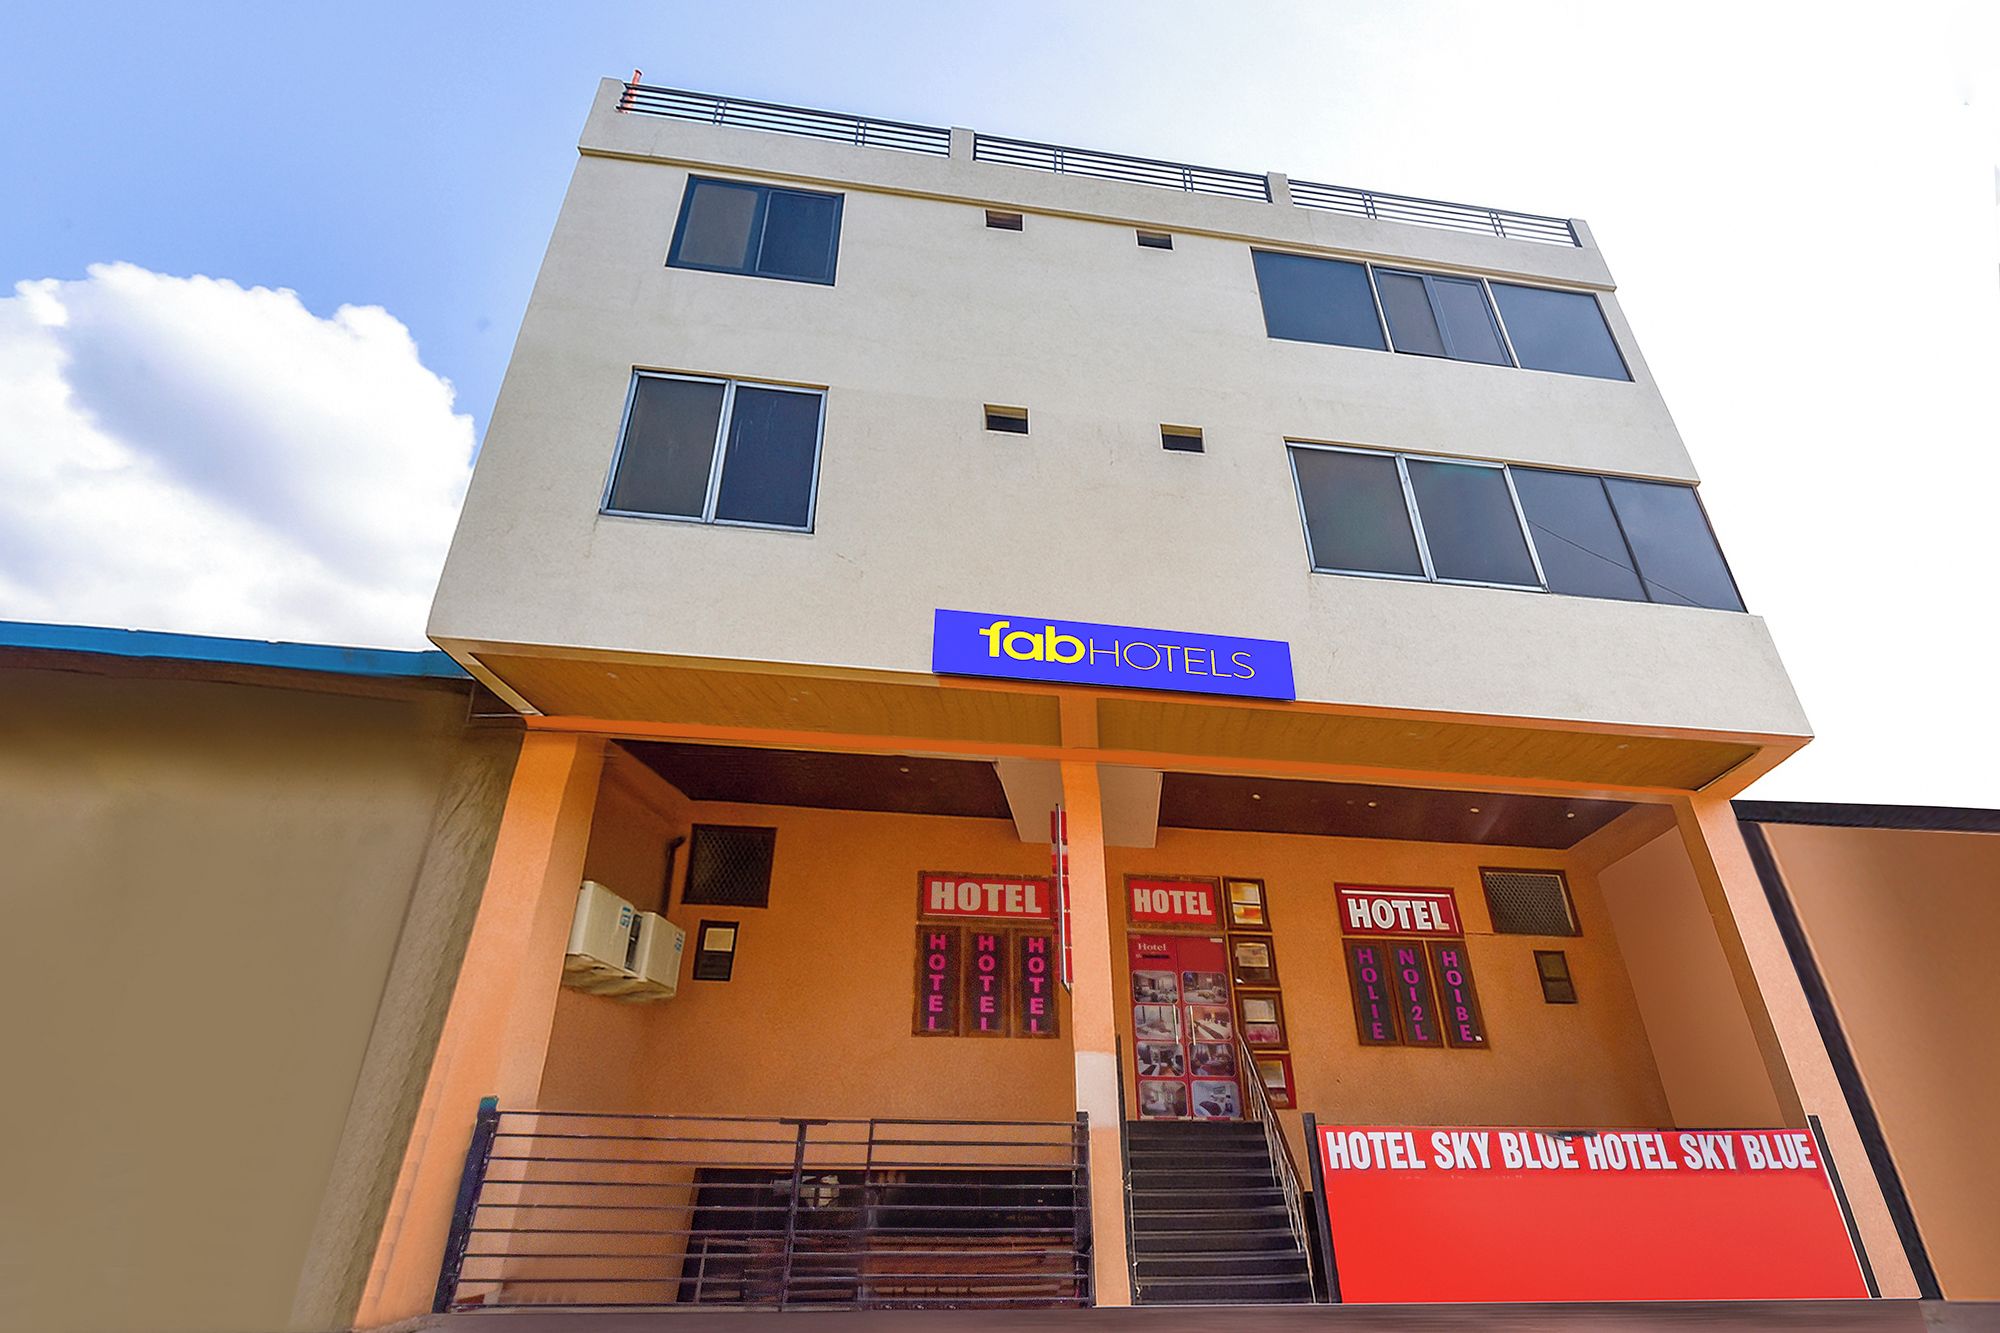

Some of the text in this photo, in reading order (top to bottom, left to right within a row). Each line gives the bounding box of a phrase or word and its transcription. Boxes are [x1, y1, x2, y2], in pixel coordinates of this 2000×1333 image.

[930, 881, 1042, 914] HOTEL
[1133, 888, 1213, 916] HOTEL
[1347, 898, 1450, 931] HOTEL
[1137, 943, 1168, 951] Hotel
[1326, 1131, 1817, 1170] HOTEL SKY BLUE HOTEL SKY BLUE
